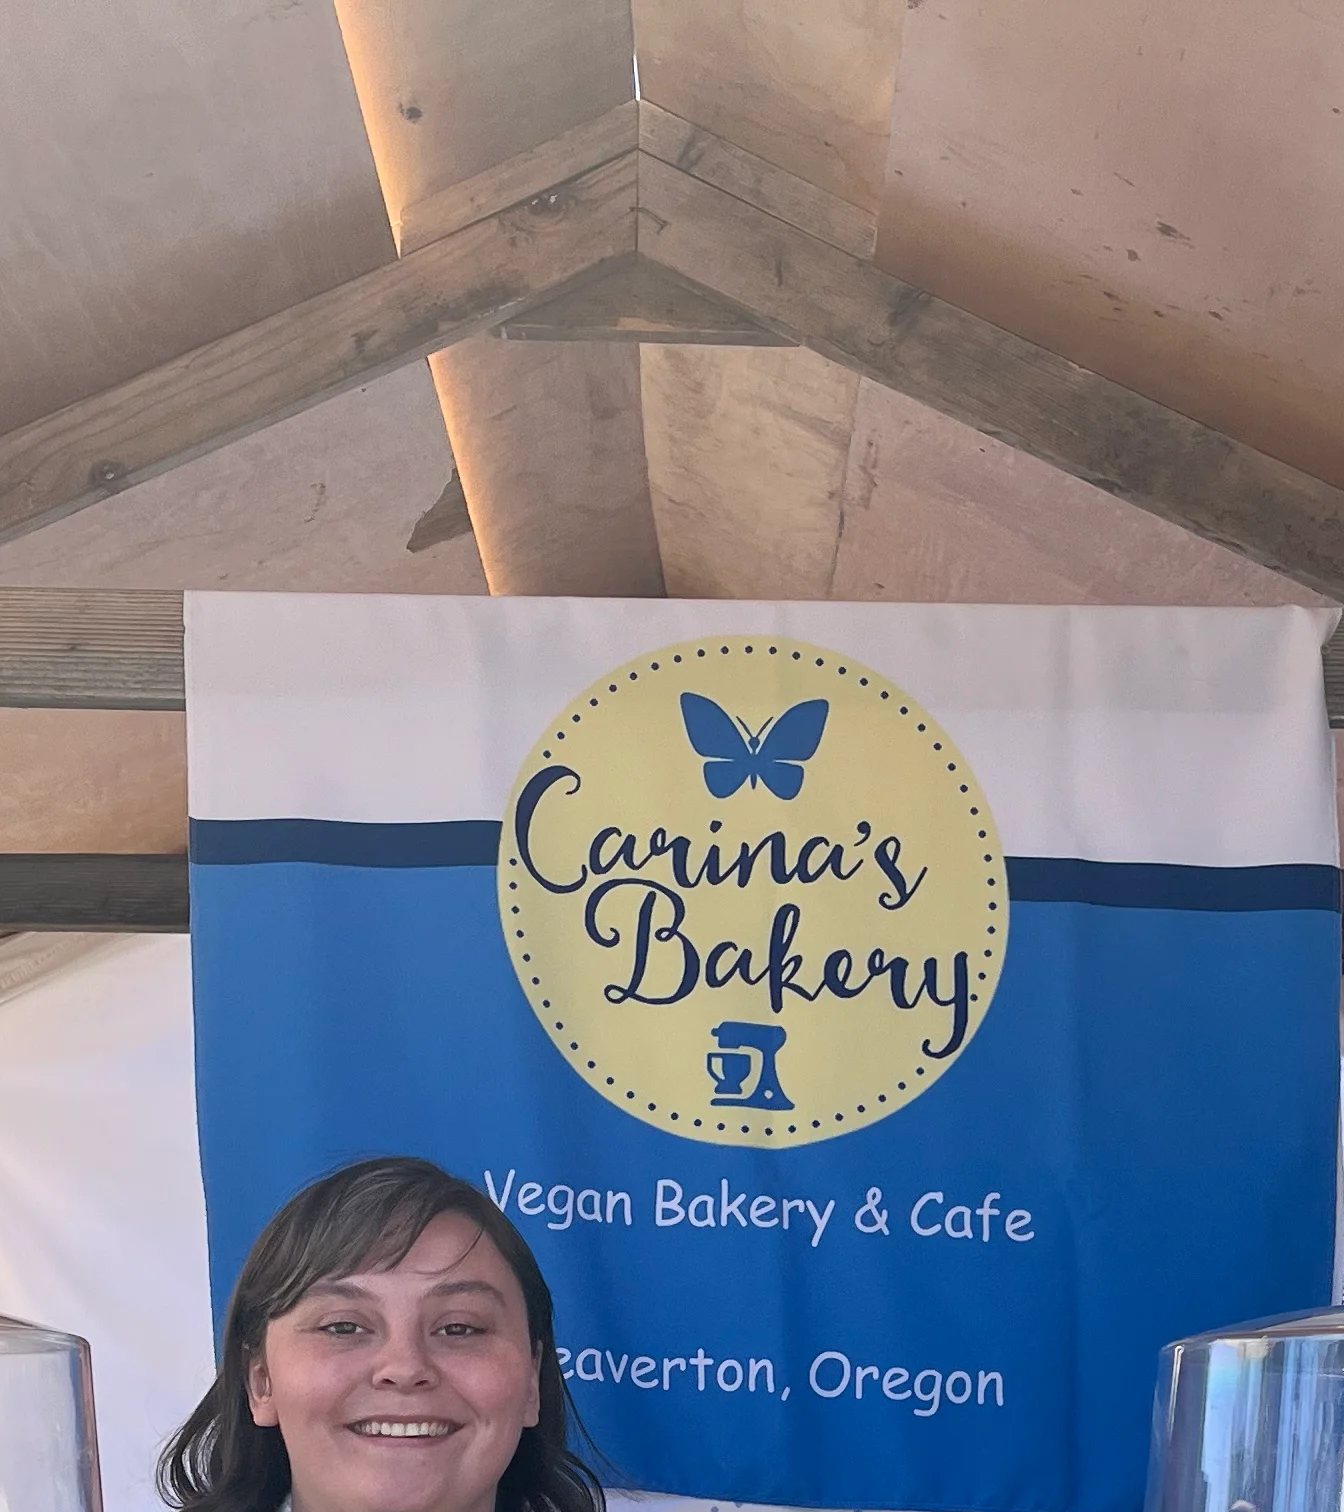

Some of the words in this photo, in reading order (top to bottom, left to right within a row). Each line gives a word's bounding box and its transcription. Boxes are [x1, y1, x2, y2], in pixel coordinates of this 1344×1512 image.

[514, 765, 928, 910] Carina's
[584, 878, 970, 1059] Bakery
[484, 1168, 633, 1231] Vegan
[655, 1178, 836, 1248] Bakery
[855, 1186, 891, 1237] &
[910, 1190, 1036, 1243] Cafe
[555, 1346, 792, 1402] eaverton,
[808, 1350, 1005, 1418] Oregon
